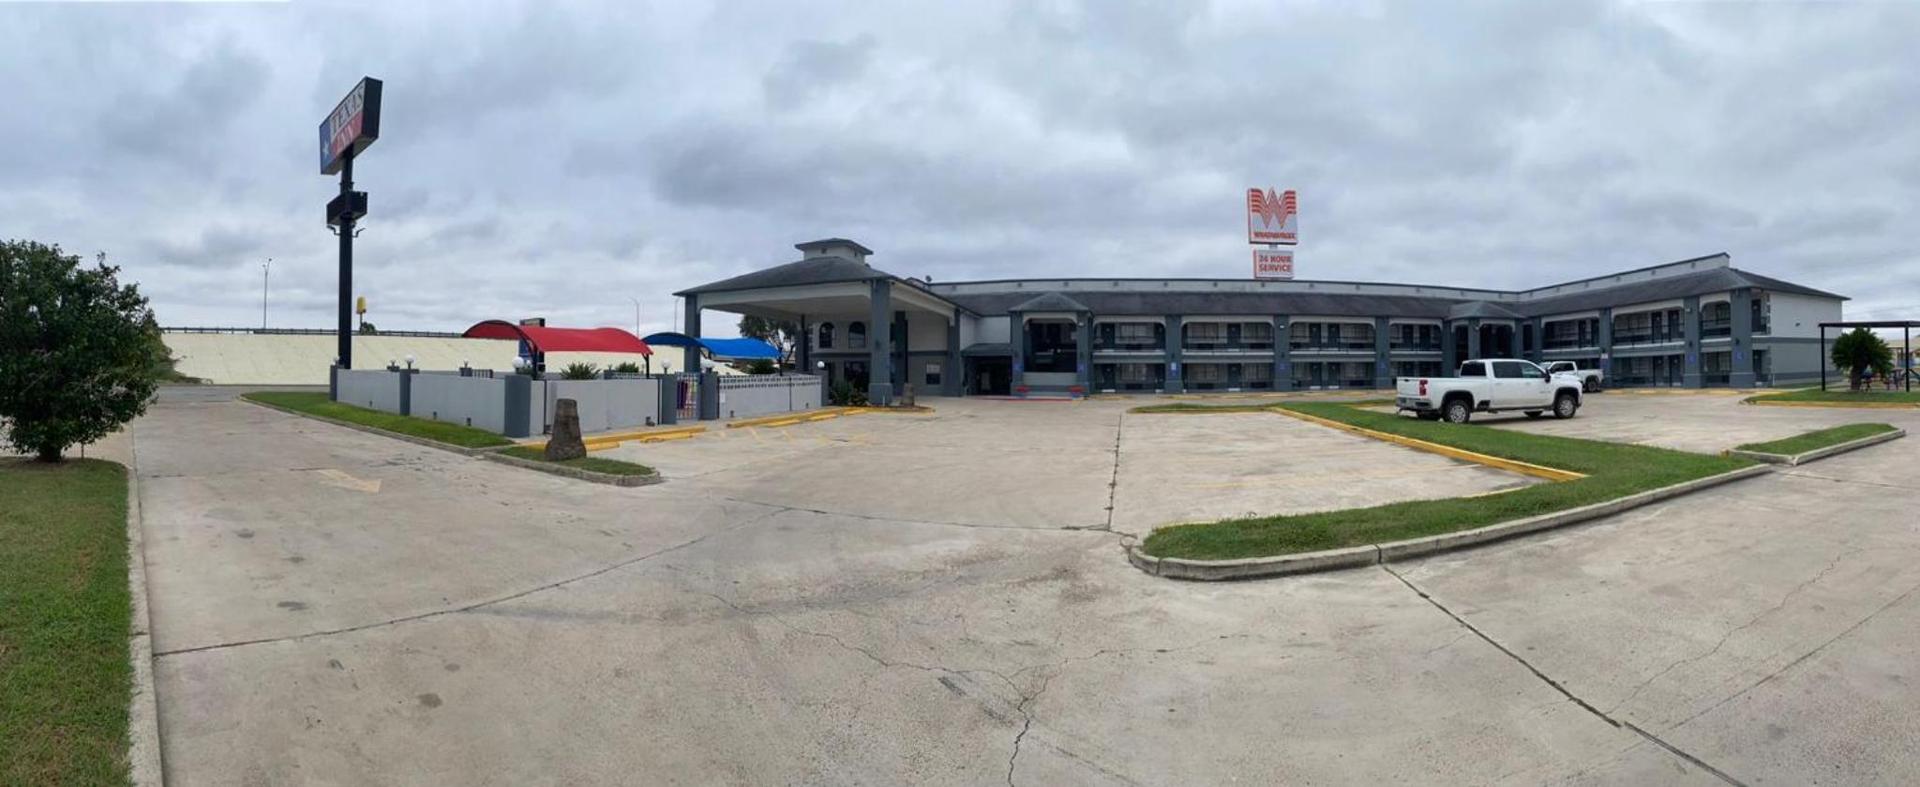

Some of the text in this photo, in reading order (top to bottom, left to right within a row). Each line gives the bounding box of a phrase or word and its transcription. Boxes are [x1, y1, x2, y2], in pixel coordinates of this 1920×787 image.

[331, 84, 364, 136] TEXAS
[1259, 255, 1292, 263] 24 HOUR
[1259, 263, 1292, 272] SERVICE
